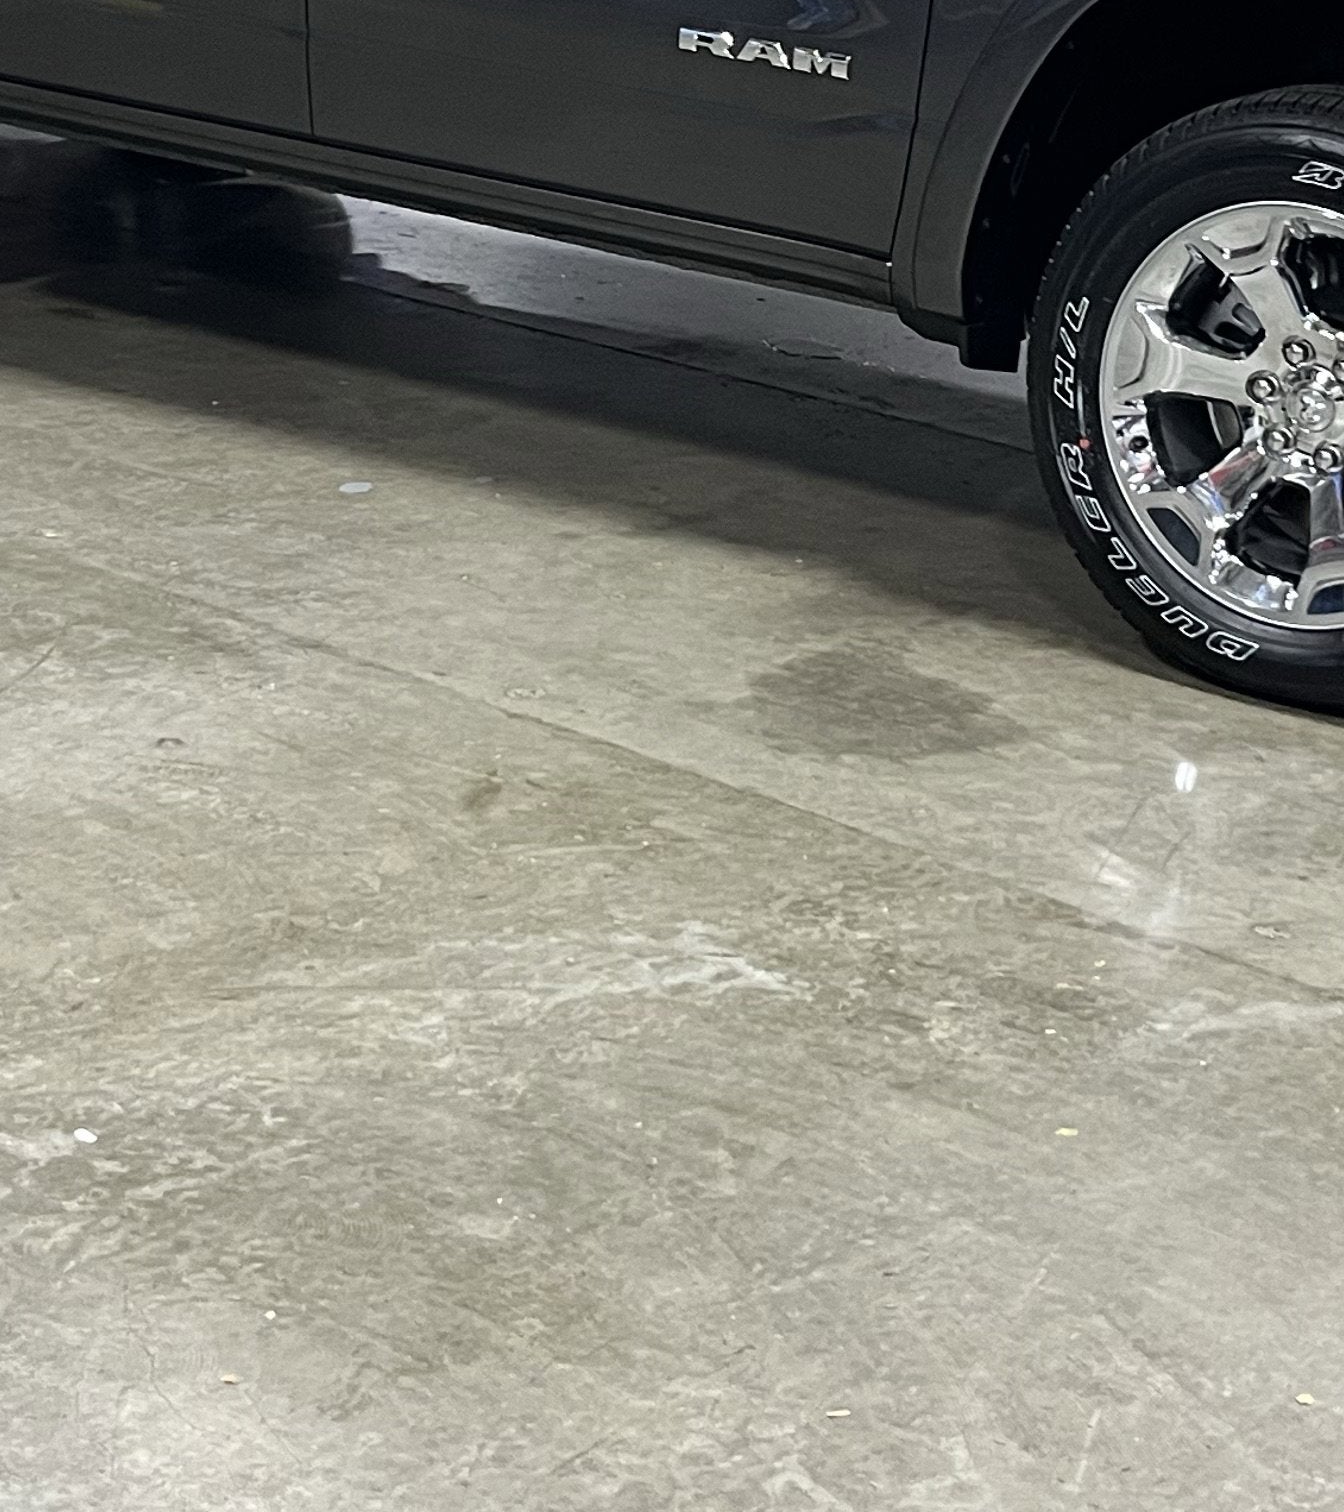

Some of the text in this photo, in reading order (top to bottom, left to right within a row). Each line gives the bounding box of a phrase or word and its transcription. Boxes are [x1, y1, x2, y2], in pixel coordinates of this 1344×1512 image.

[678, 26, 852, 81] RAM
[1053, 296, 1259, 661] DUELER H/L
